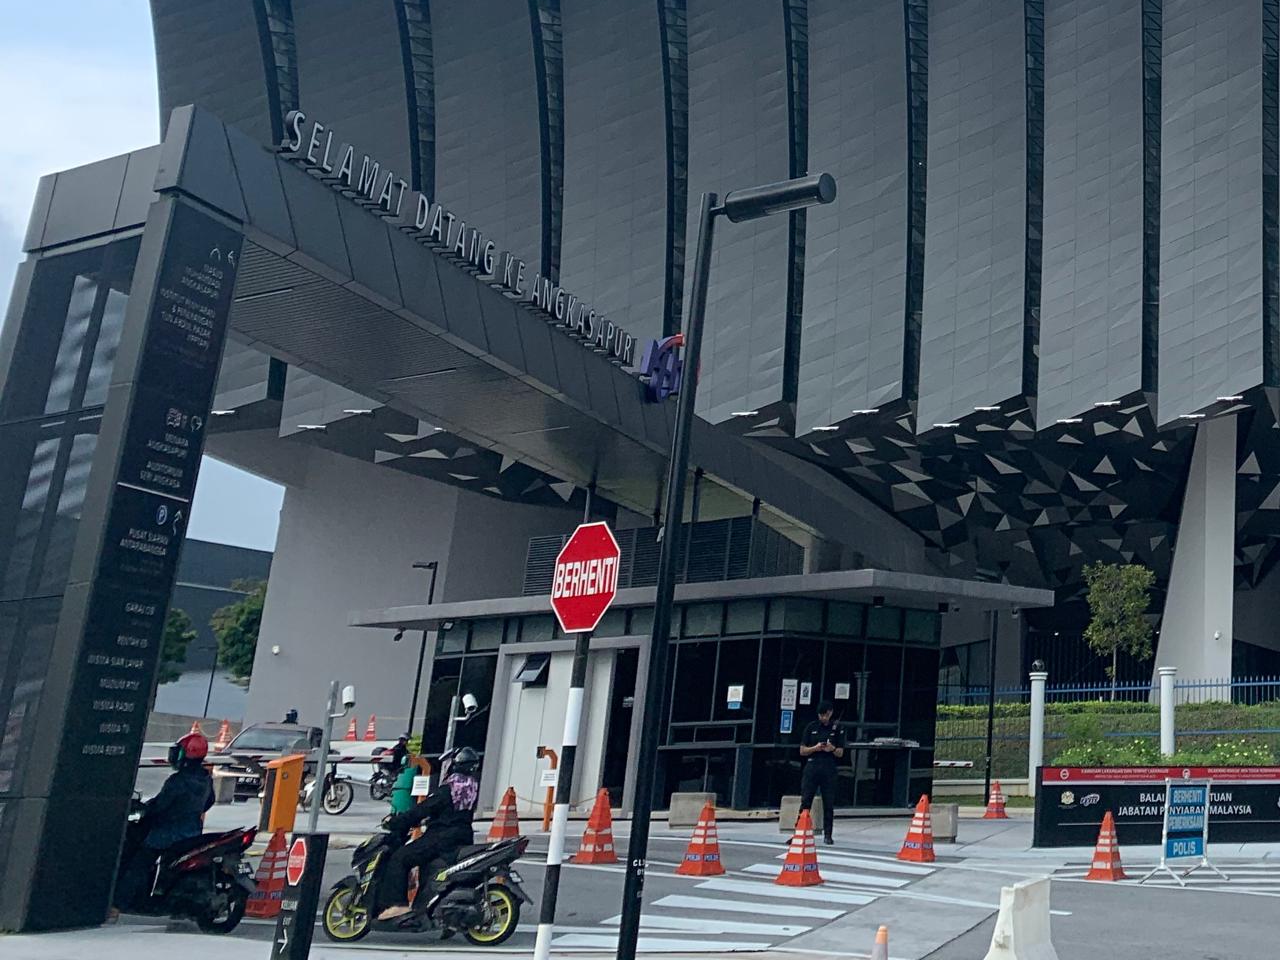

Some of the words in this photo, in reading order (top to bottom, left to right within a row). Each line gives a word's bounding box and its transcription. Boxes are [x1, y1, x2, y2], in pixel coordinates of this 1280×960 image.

[288, 112, 408, 215] SELAMAT
[416, 193, 496, 274] DATANG
[503, 252, 525, 294] KE
[531, 272, 637, 368] ANGKASAPURI
[553, 556, 617, 598] BERHENTI
[1139, 793, 1165, 802] BALAI
[1209, 792, 1232, 802] TUAN
[1118, 806, 1157, 816] JABATAN
[1159, 806, 1206, 816] PNYIARAN
[1209, 805, 1252, 815] MALAYSIA
[1173, 841, 1196, 856] POLIS
